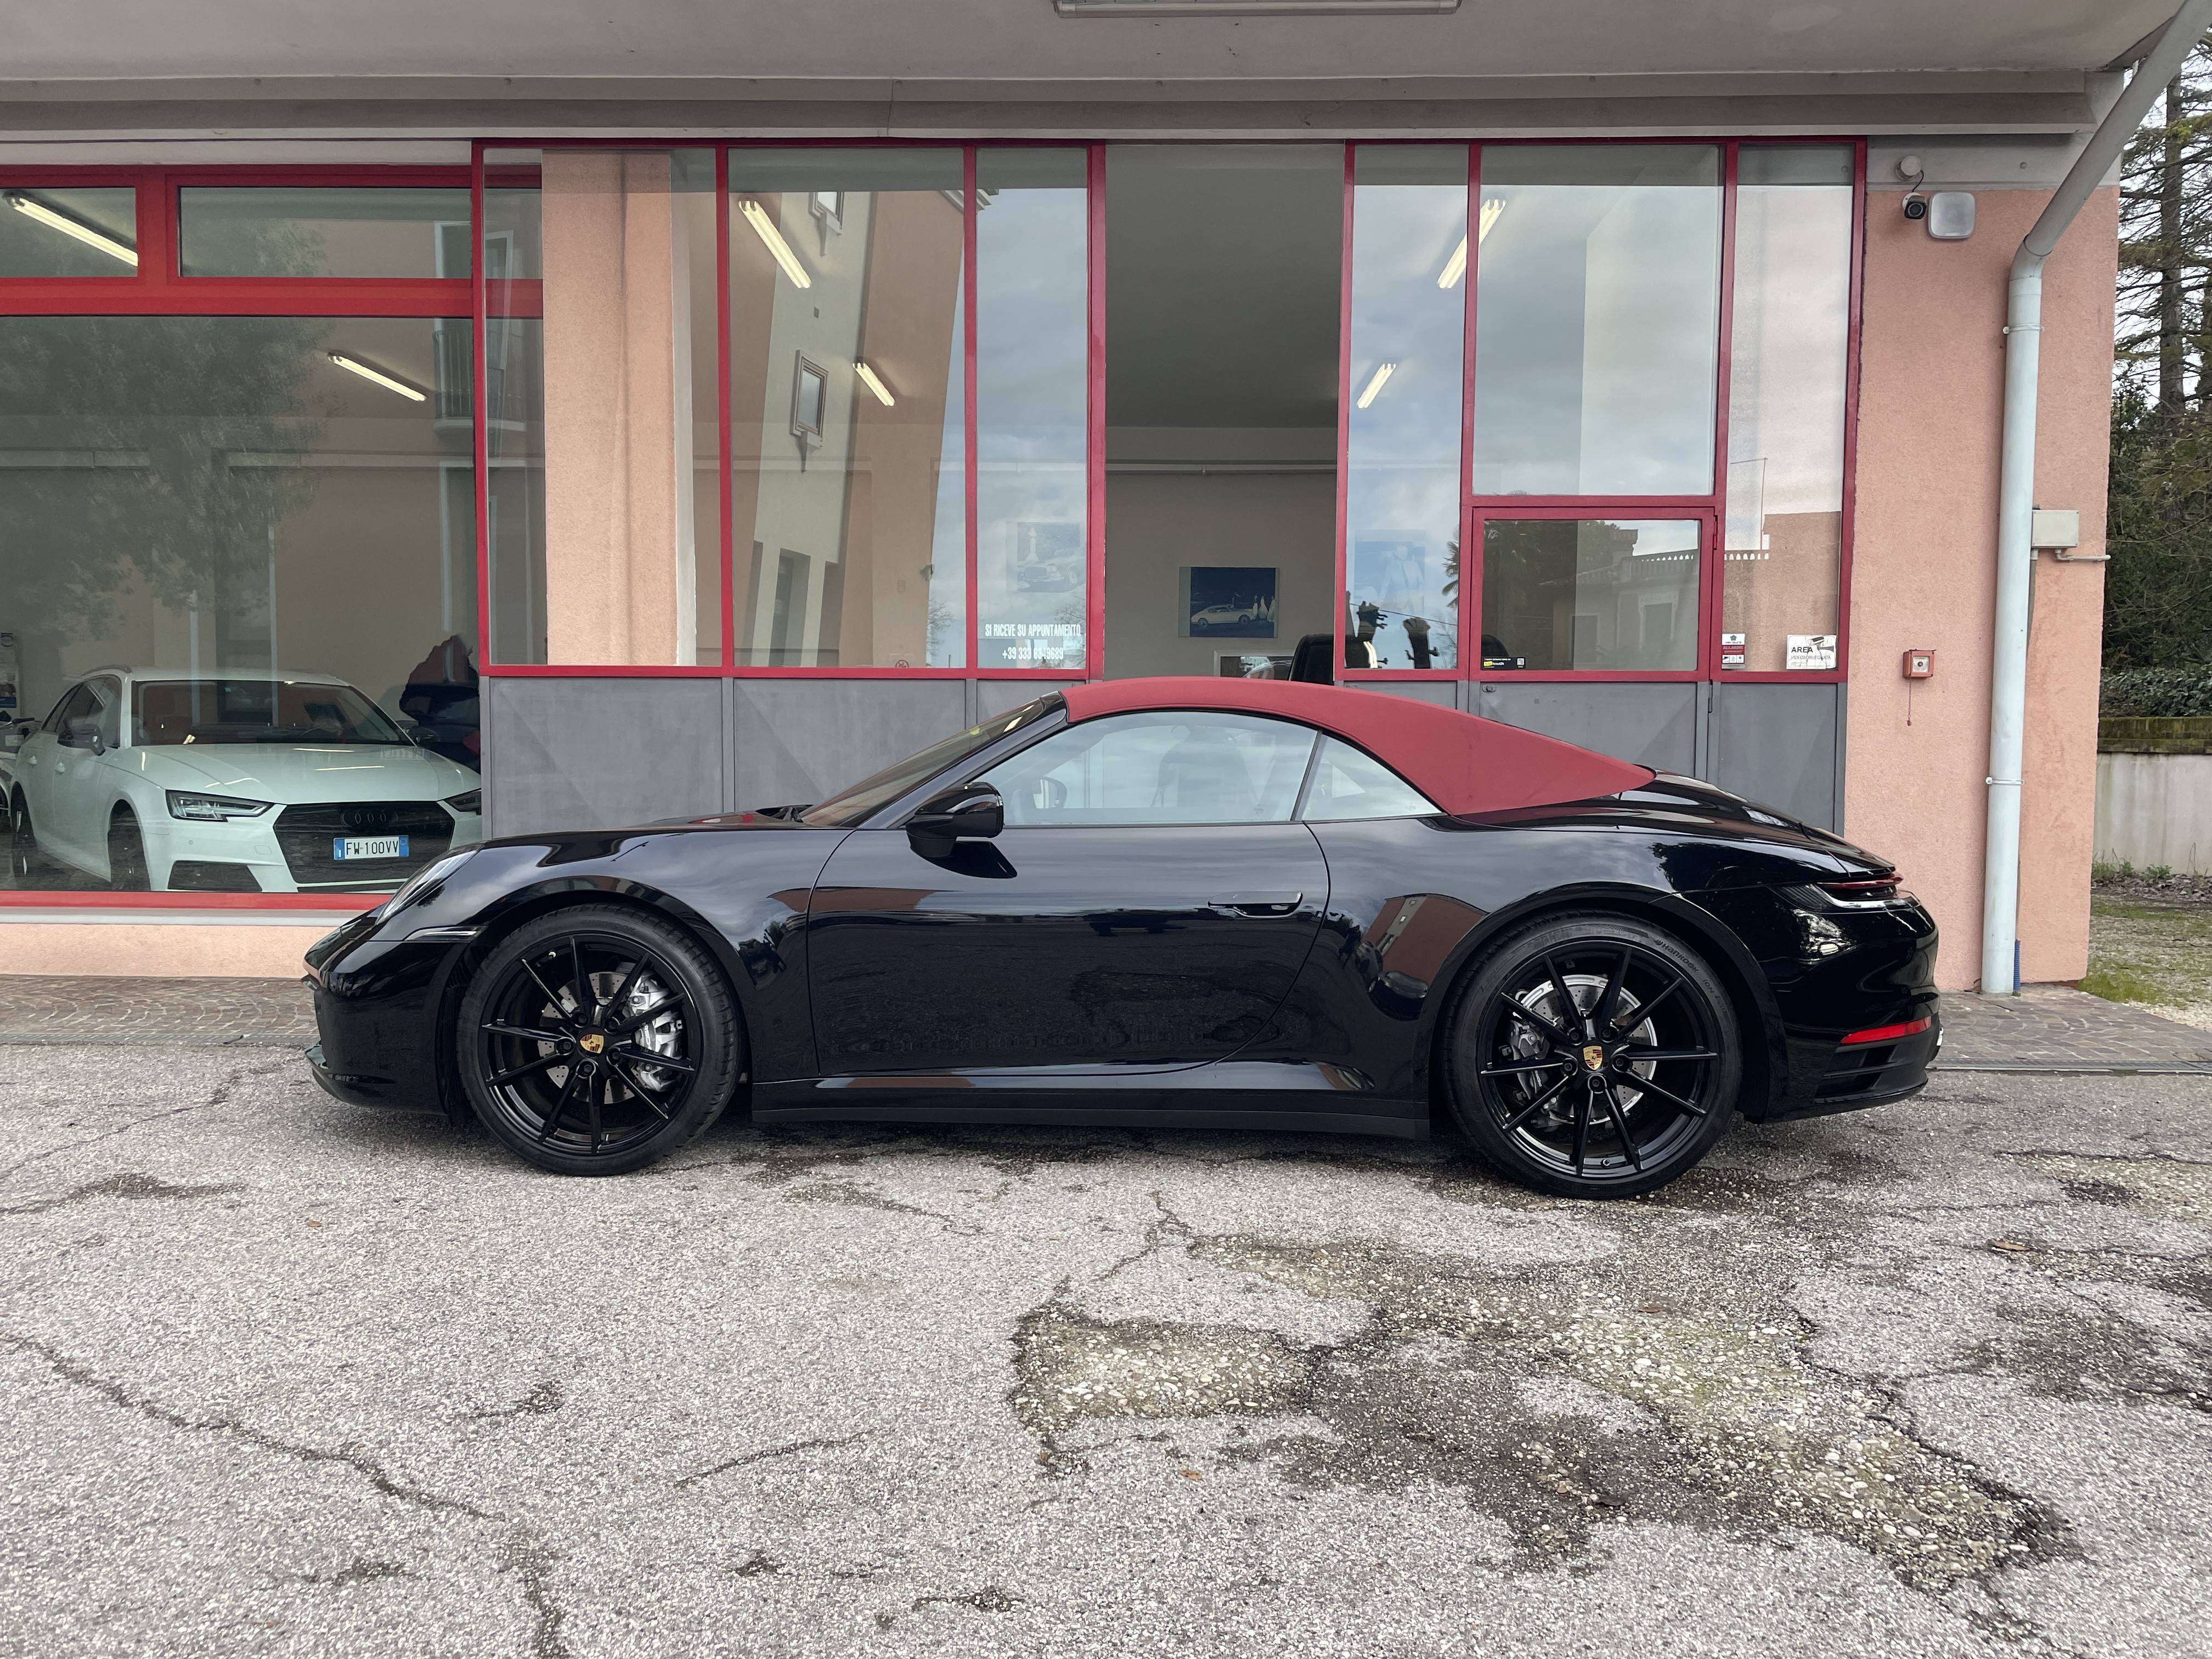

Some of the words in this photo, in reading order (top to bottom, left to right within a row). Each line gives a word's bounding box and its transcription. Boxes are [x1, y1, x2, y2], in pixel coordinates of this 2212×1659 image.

[985, 624, 991, 637] SI
[994, 624, 1016, 637] RICEVE
[1017, 624, 1026, 637] SU
[1028, 624, 1081, 637] APPUNTAMENTO
[1002, 647, 1016, 660] +39
[1018, 647, 1032, 660] 333
